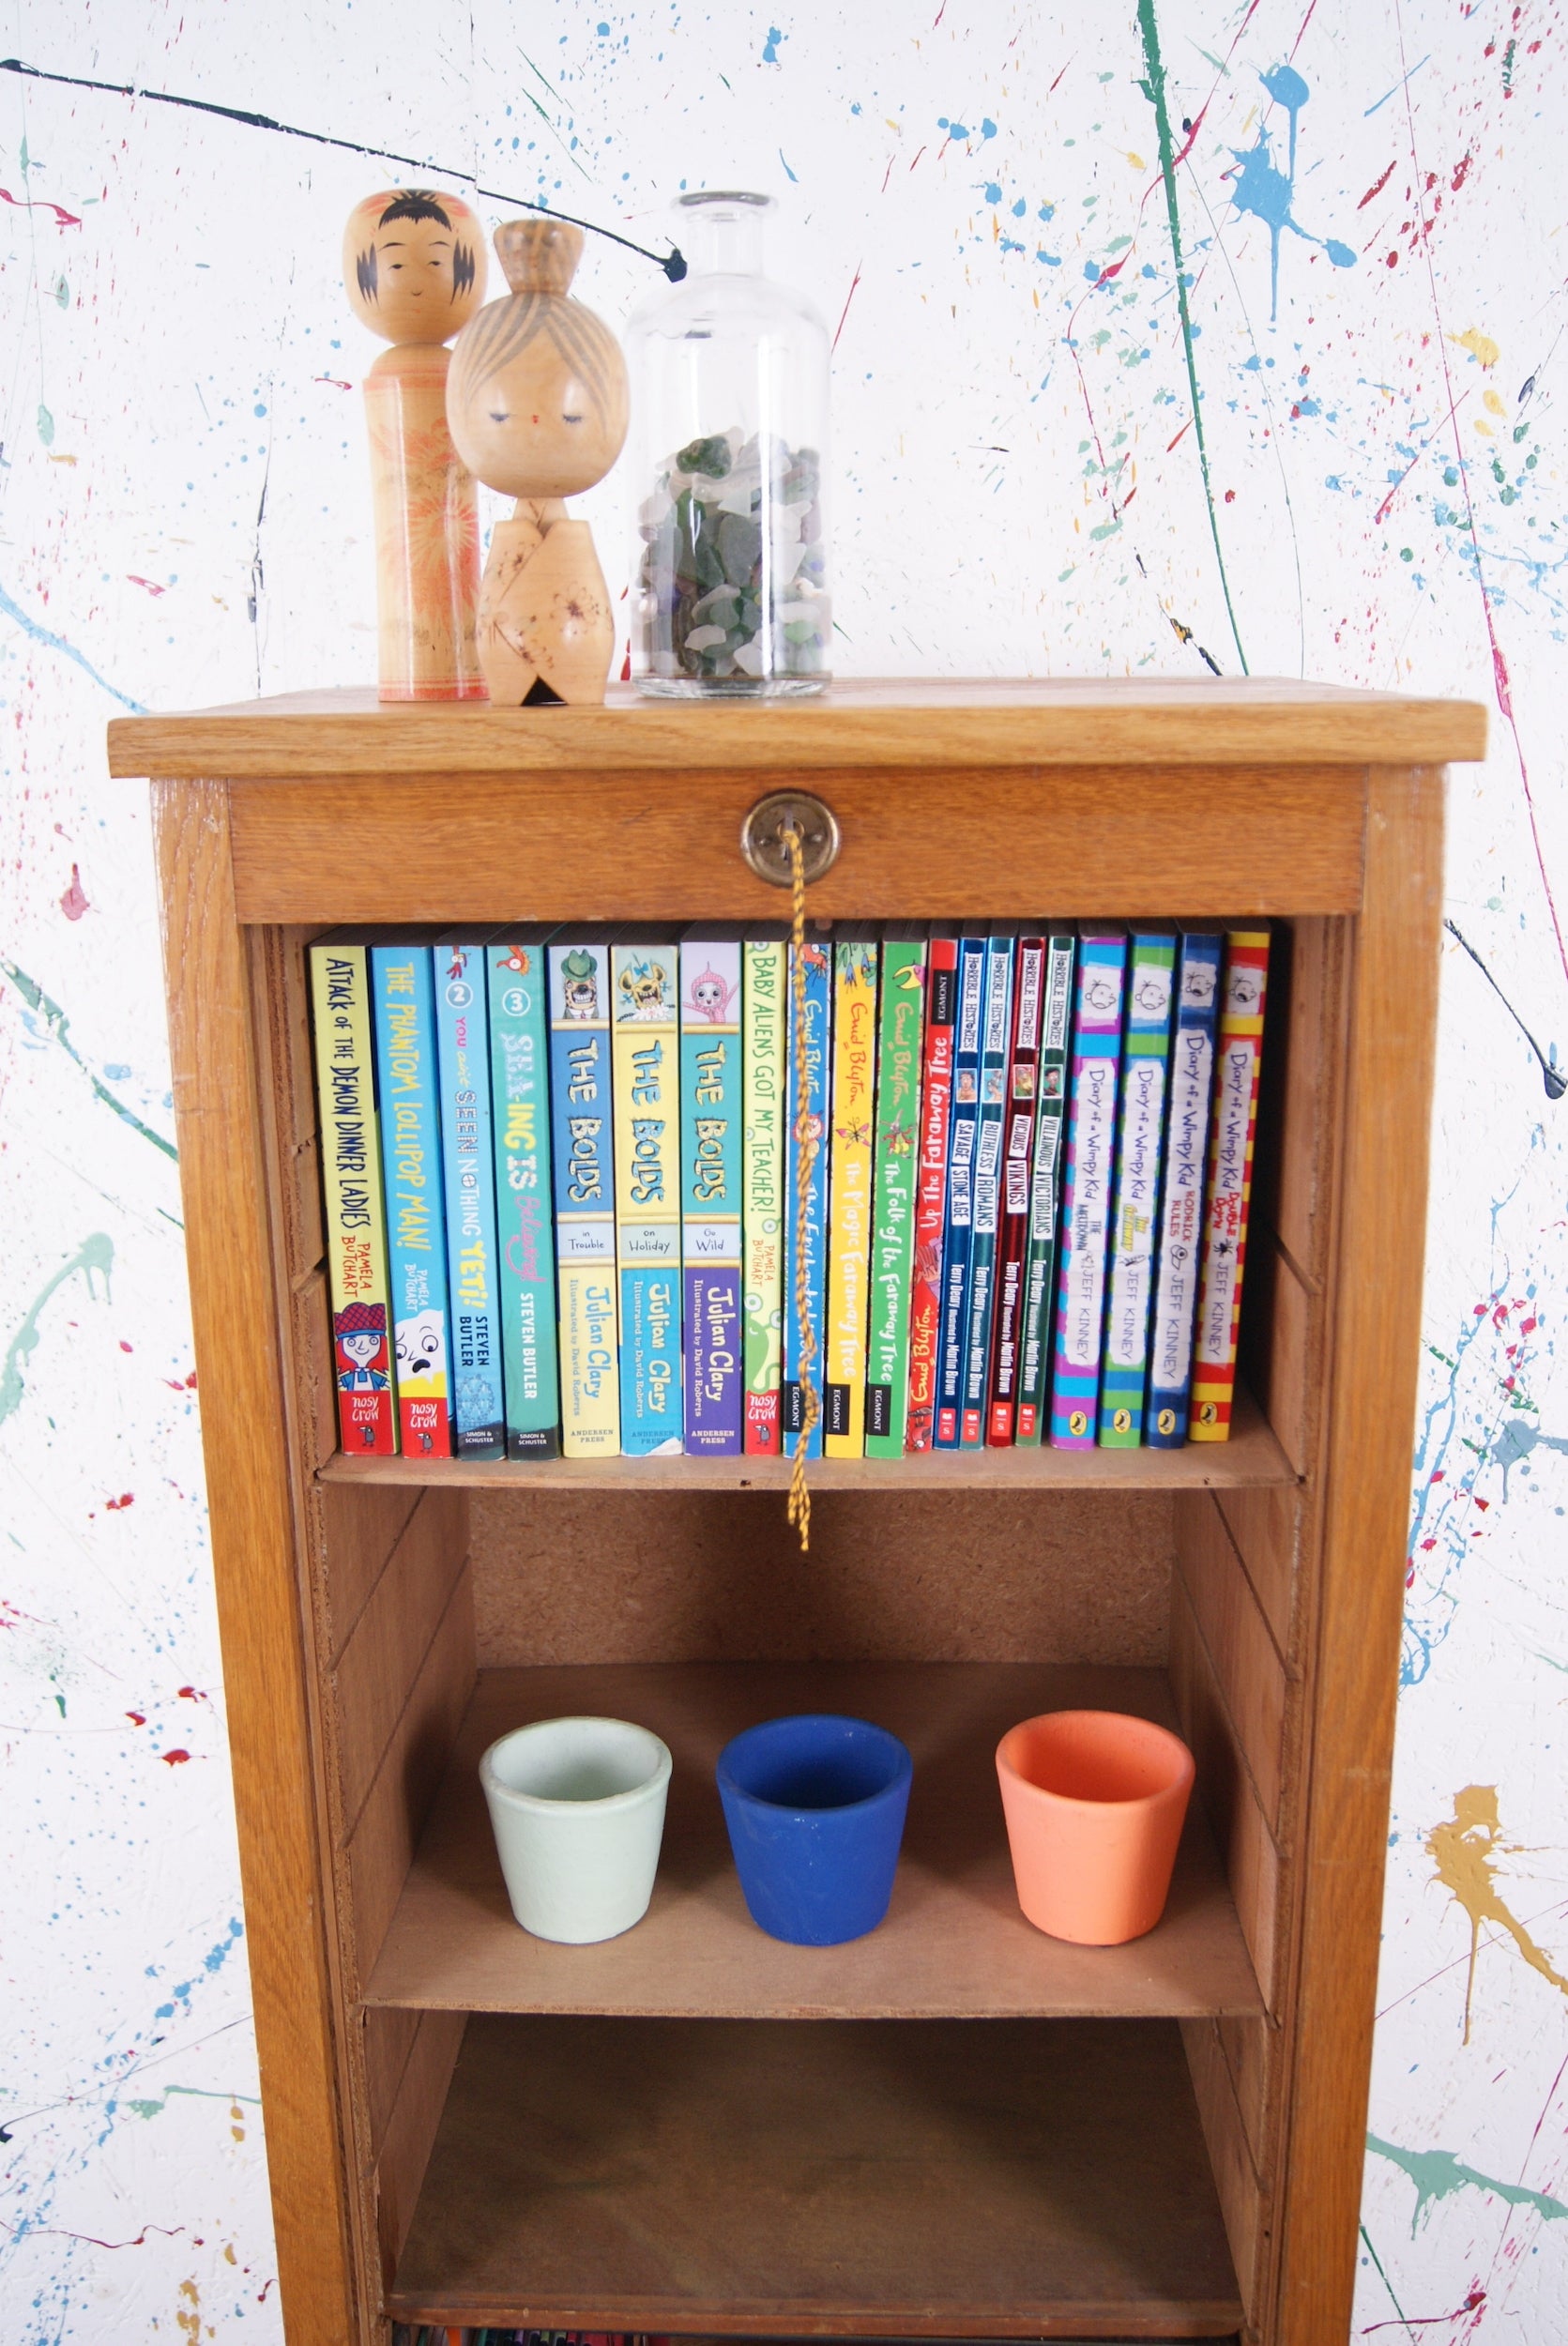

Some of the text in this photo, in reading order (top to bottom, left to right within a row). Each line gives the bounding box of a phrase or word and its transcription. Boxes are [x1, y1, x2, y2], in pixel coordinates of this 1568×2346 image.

[326, 958, 355, 1011] ATTACK
[453, 986, 464, 1002] 2
[510, 993, 523, 1011] 3
[938, 976, 948, 1019] EGMONT
[334, 1037, 354, 1059] THE
[456, 1016, 467, 1047] YOU
[846, 1003, 868, 1105] Enid Blyton
[329, 1066, 361, 1116] DEMON
[751, 956, 776, 1212] BABY ALIENS GOT MY TEACHER!
[891, 1051, 911, 1106] Blyton
[386, 963, 432, 1250] THE PHANTOM LOLLIPOP MAN!
[455, 1090, 478, 1153] SEEN
[567, 1037, 602, 1203] THE BOLDS
[631, 1040, 666, 1205] THE BOLDS
[693, 1041, 729, 1202] THE BOLDS
[1176, 1036, 1205, 1186] Diary Wimpy Kid
[1221, 1053, 1247, 1190] Diary Wimpy Kid
[335, 1122, 367, 1172] DINNER
[920, 1037, 950, 1228] Up The Faraway Tree
[955, 1124, 973, 1159] SAVAGE
[980, 1124, 999, 1173] RUTHLESS
[1012, 1119, 1028, 1151] VICIOUS
[1039, 1119, 1058, 1172] VILLAINOUS
[1083, 1069, 1105, 1199] Diary Wimpy Kid
[1130, 1070, 1153, 1199] Diary Wimpy Kid
[507, 1154, 538, 1190] IS
[953, 1170, 968, 1218] STONE AGE
[1009, 1164, 1026, 1206] VIKINGS
[339, 1180, 372, 1228] LADIES
[458, 1159, 481, 1236] NOTHING
[977, 1180, 994, 1227] ROMANS
[1035, 1177, 1051, 1234] VICTORIANS
[1170, 1200, 1181, 1237] RULES
[1183, 1191, 1195, 1242] RODRICK
[569, 1239, 604, 1250] Trouble
[583, 1229, 590, 1238] in
[630, 1241, 670, 1254] Holiday
[696, 1240, 724, 1251] Wild
[704, 1228, 716, 1237] Go
[342, 1235, 358, 1297] BUTCHART
[358, 1242, 373, 1289] PAMELA
[417, 1269, 430, 1306] PAMELA
[752, 1240, 764, 1287] BUTCHART
[765, 1246, 775, 1281] PAMELA
[838, 1163, 865, 1378] The Magic Faraway Tree
[878, 1162, 907, 1381] The Folk of the Faraway Tree
[950, 1264, 965, 1285] Terry
[974, 1267, 990, 1287] Terry
[1005, 1261, 1020, 1282] Terry
[1030, 1259, 1046, 1279] Terry
[404, 1264, 419, 1312] BUTCHART
[1209, 1262, 1229, 1356] JEFF KINNEY
[1076, 1270, 1093, 1361] JEFF KINNEY
[1121, 1270, 1138, 1360] JEFF KINNEY
[1164, 1274, 1184, 1379] JEFF KINNEY
[460, 1317, 474, 1367] BUTLER
[475, 1316, 489, 1366] STEVEN
[521, 1292, 537, 1398] STEVEN BUTLER
[584, 1287, 613, 1398] Julian Clary
[647, 1283, 671, 1413] Julian Clary
[693, 1280, 704, 1417] Illustrated by David Roberts
[706, 1287, 736, 1401] Julian Clary
[911, 1304, 935, 1402] Enid Blyton
[946, 1345, 959, 1370] Martin
[970, 1347, 984, 1372] Martin
[1000, 1342, 1014, 1367] Martin
[1027, 1340, 1040, 1365] Martin
[751, 1395, 776, 1410] nosy
[945, 1371, 959, 1395] Brown
[968, 1374, 982, 1398] Brown
[998, 1368, 1013, 1394] Brown
[1025, 1365, 1039, 1392] Brown
[352, 1396, 379, 1411] nosy
[410, 1403, 437, 1419] nosy
